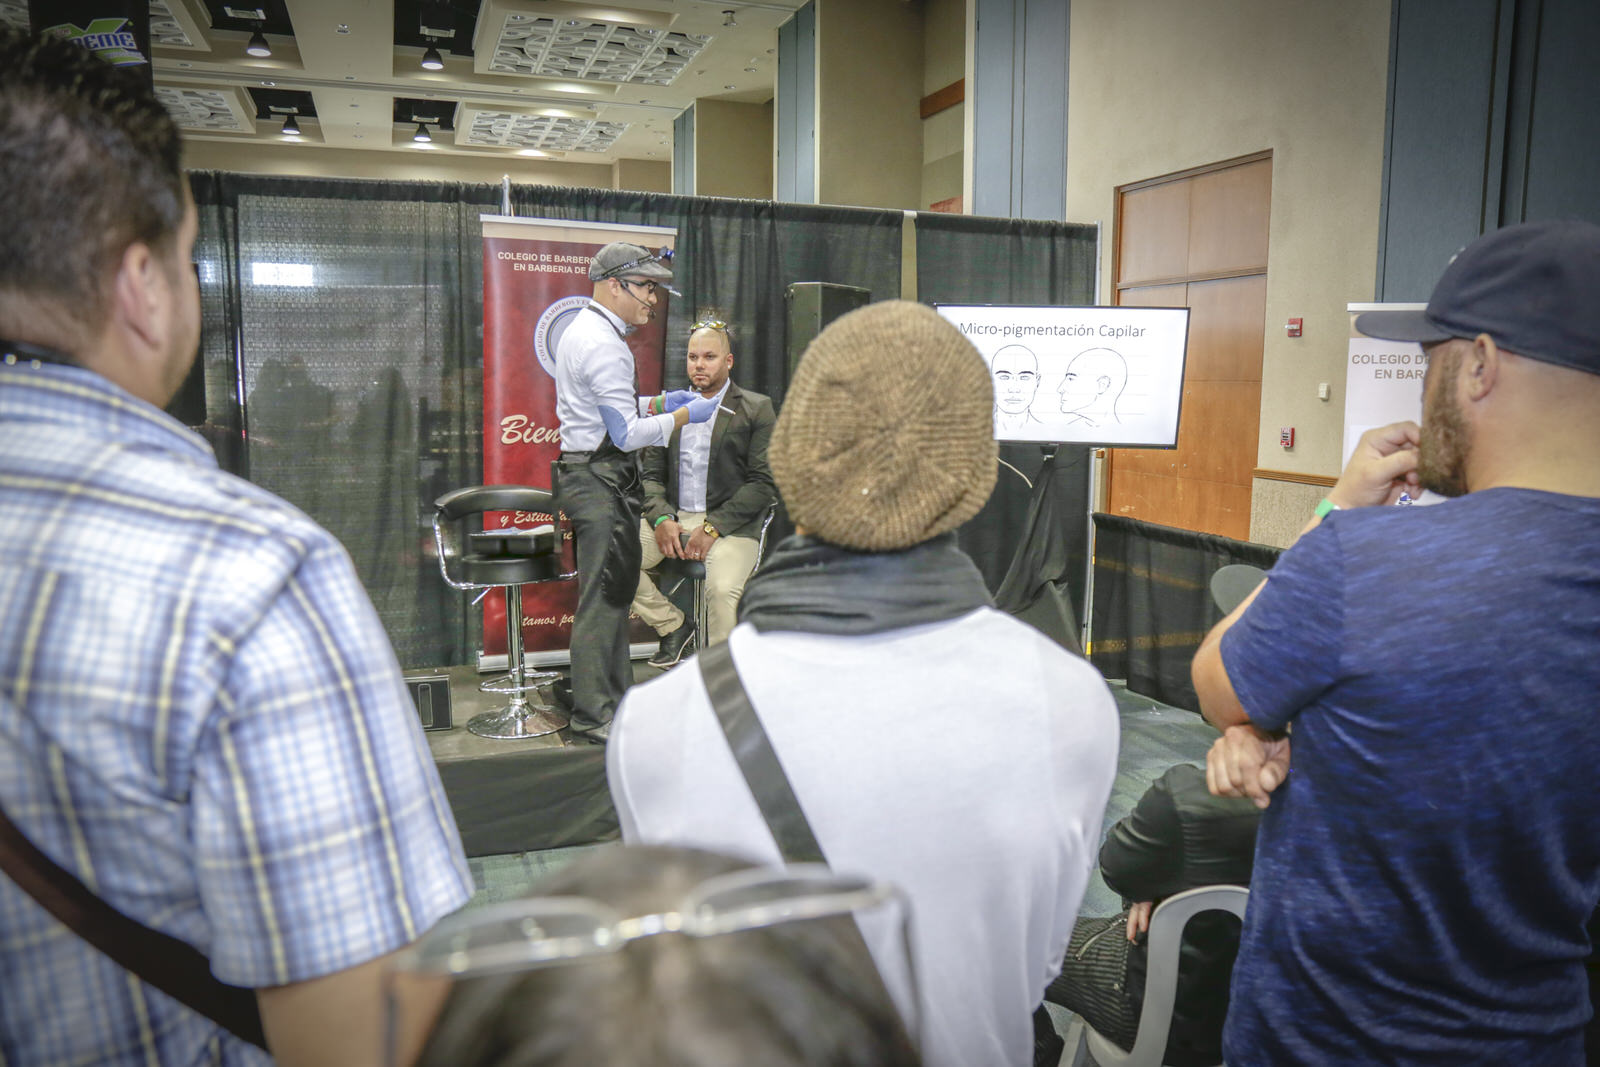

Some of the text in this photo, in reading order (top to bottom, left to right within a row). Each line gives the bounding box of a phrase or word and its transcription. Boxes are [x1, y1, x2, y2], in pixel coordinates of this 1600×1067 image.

[498, 251, 538, 262] COLEGIO
[540, 253, 552, 263] DE
[513, 263, 586, 275] EN BARBERIA DE
[959, 322, 1146, 339] Micro-pigmentación Capilar
[1352, 354, 1411, 365] COLEGIO
[1375, 369, 1392, 379] EN
[500, 414, 562, 444] Bien
[500, 514, 509, 527] y
